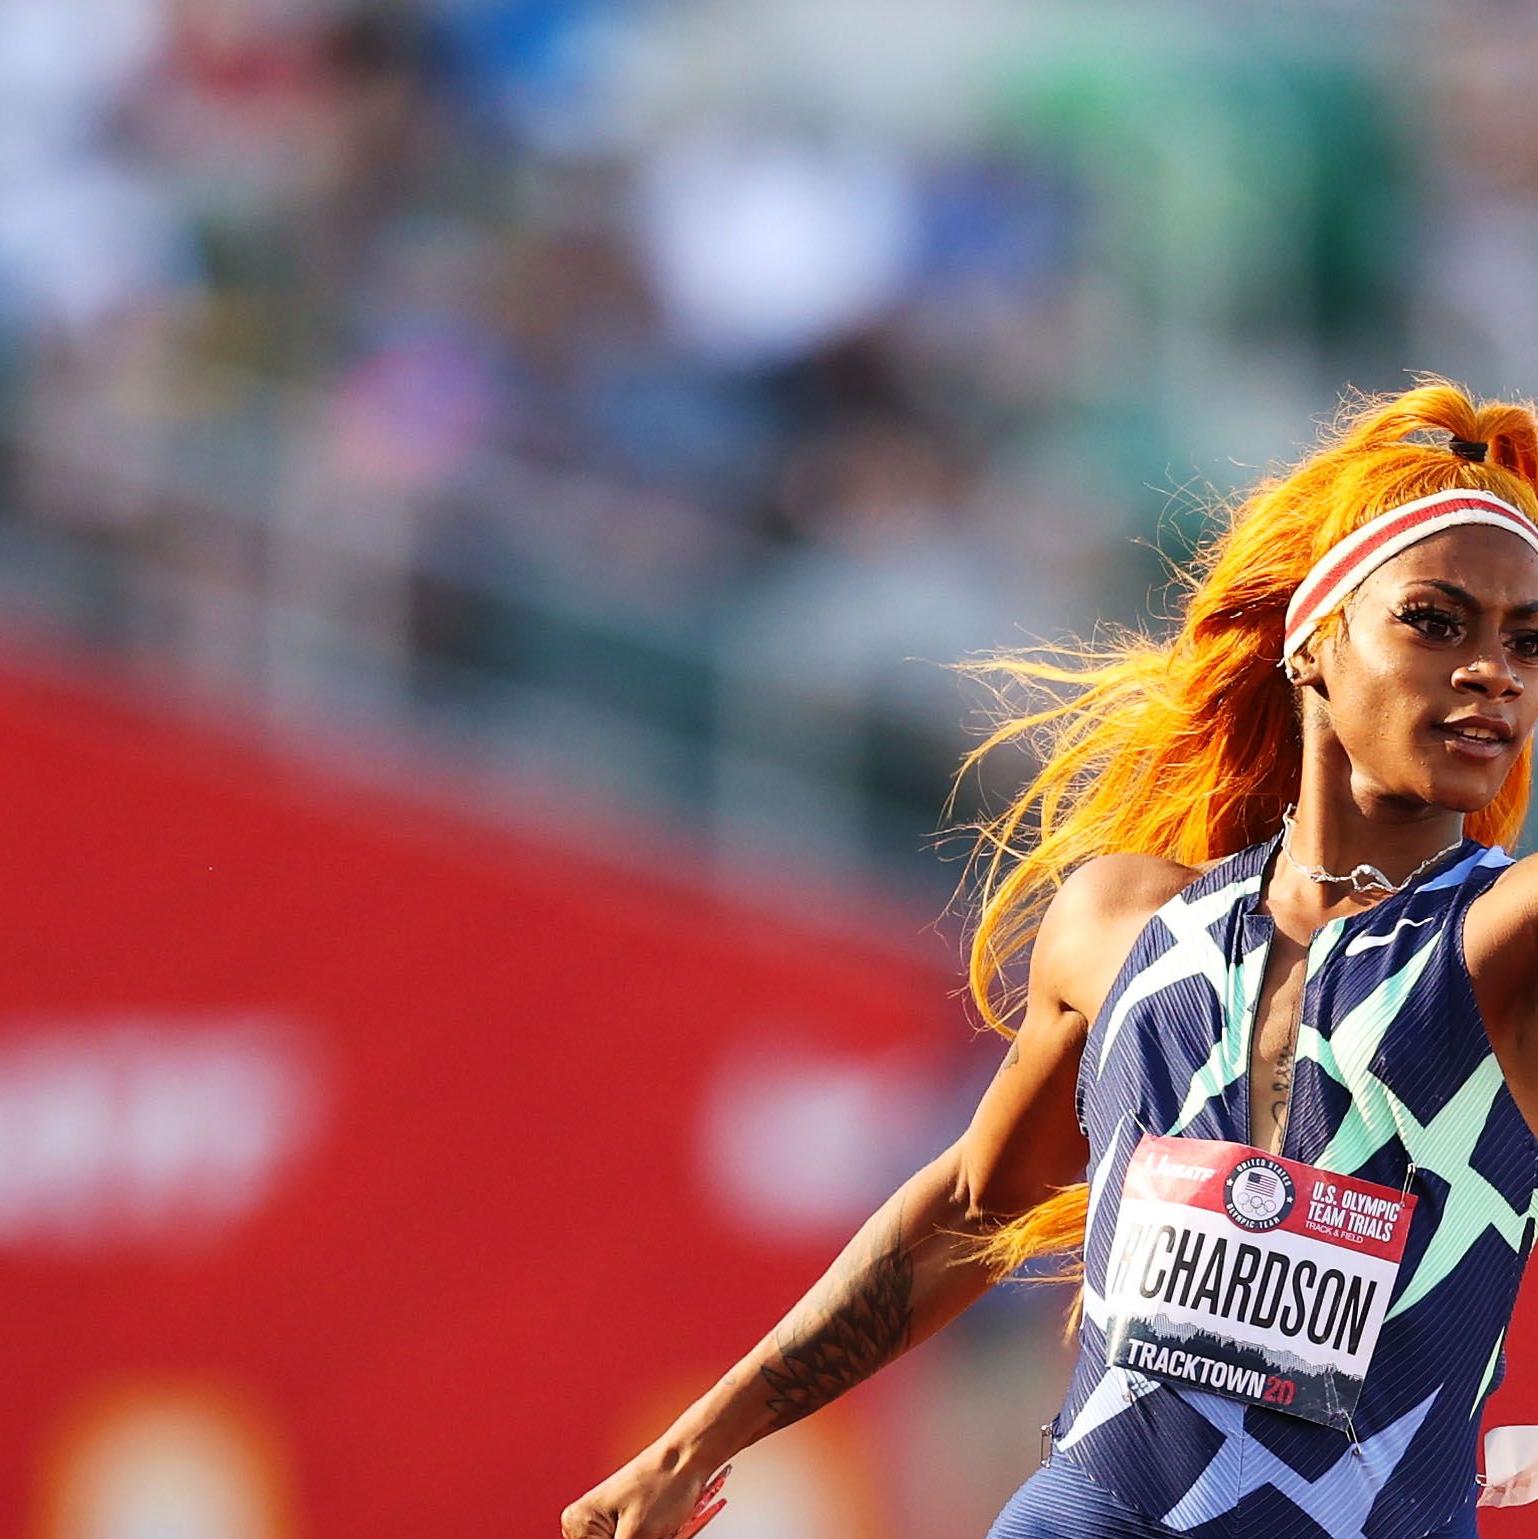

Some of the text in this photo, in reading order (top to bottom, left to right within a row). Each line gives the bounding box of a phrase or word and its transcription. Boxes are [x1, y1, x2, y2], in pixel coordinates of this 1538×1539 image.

[1236, 1158, 1292, 1187] UNITED STATES
[1226, 1203, 1281, 1229] OLYMPIC TEAM
[1312, 1181, 1401, 1222] U.S. OLYMPIC
[1305, 1220, 1364, 1244] TRACK & FIELD
[1307, 1200, 1393, 1243] TEAM TRIALS
